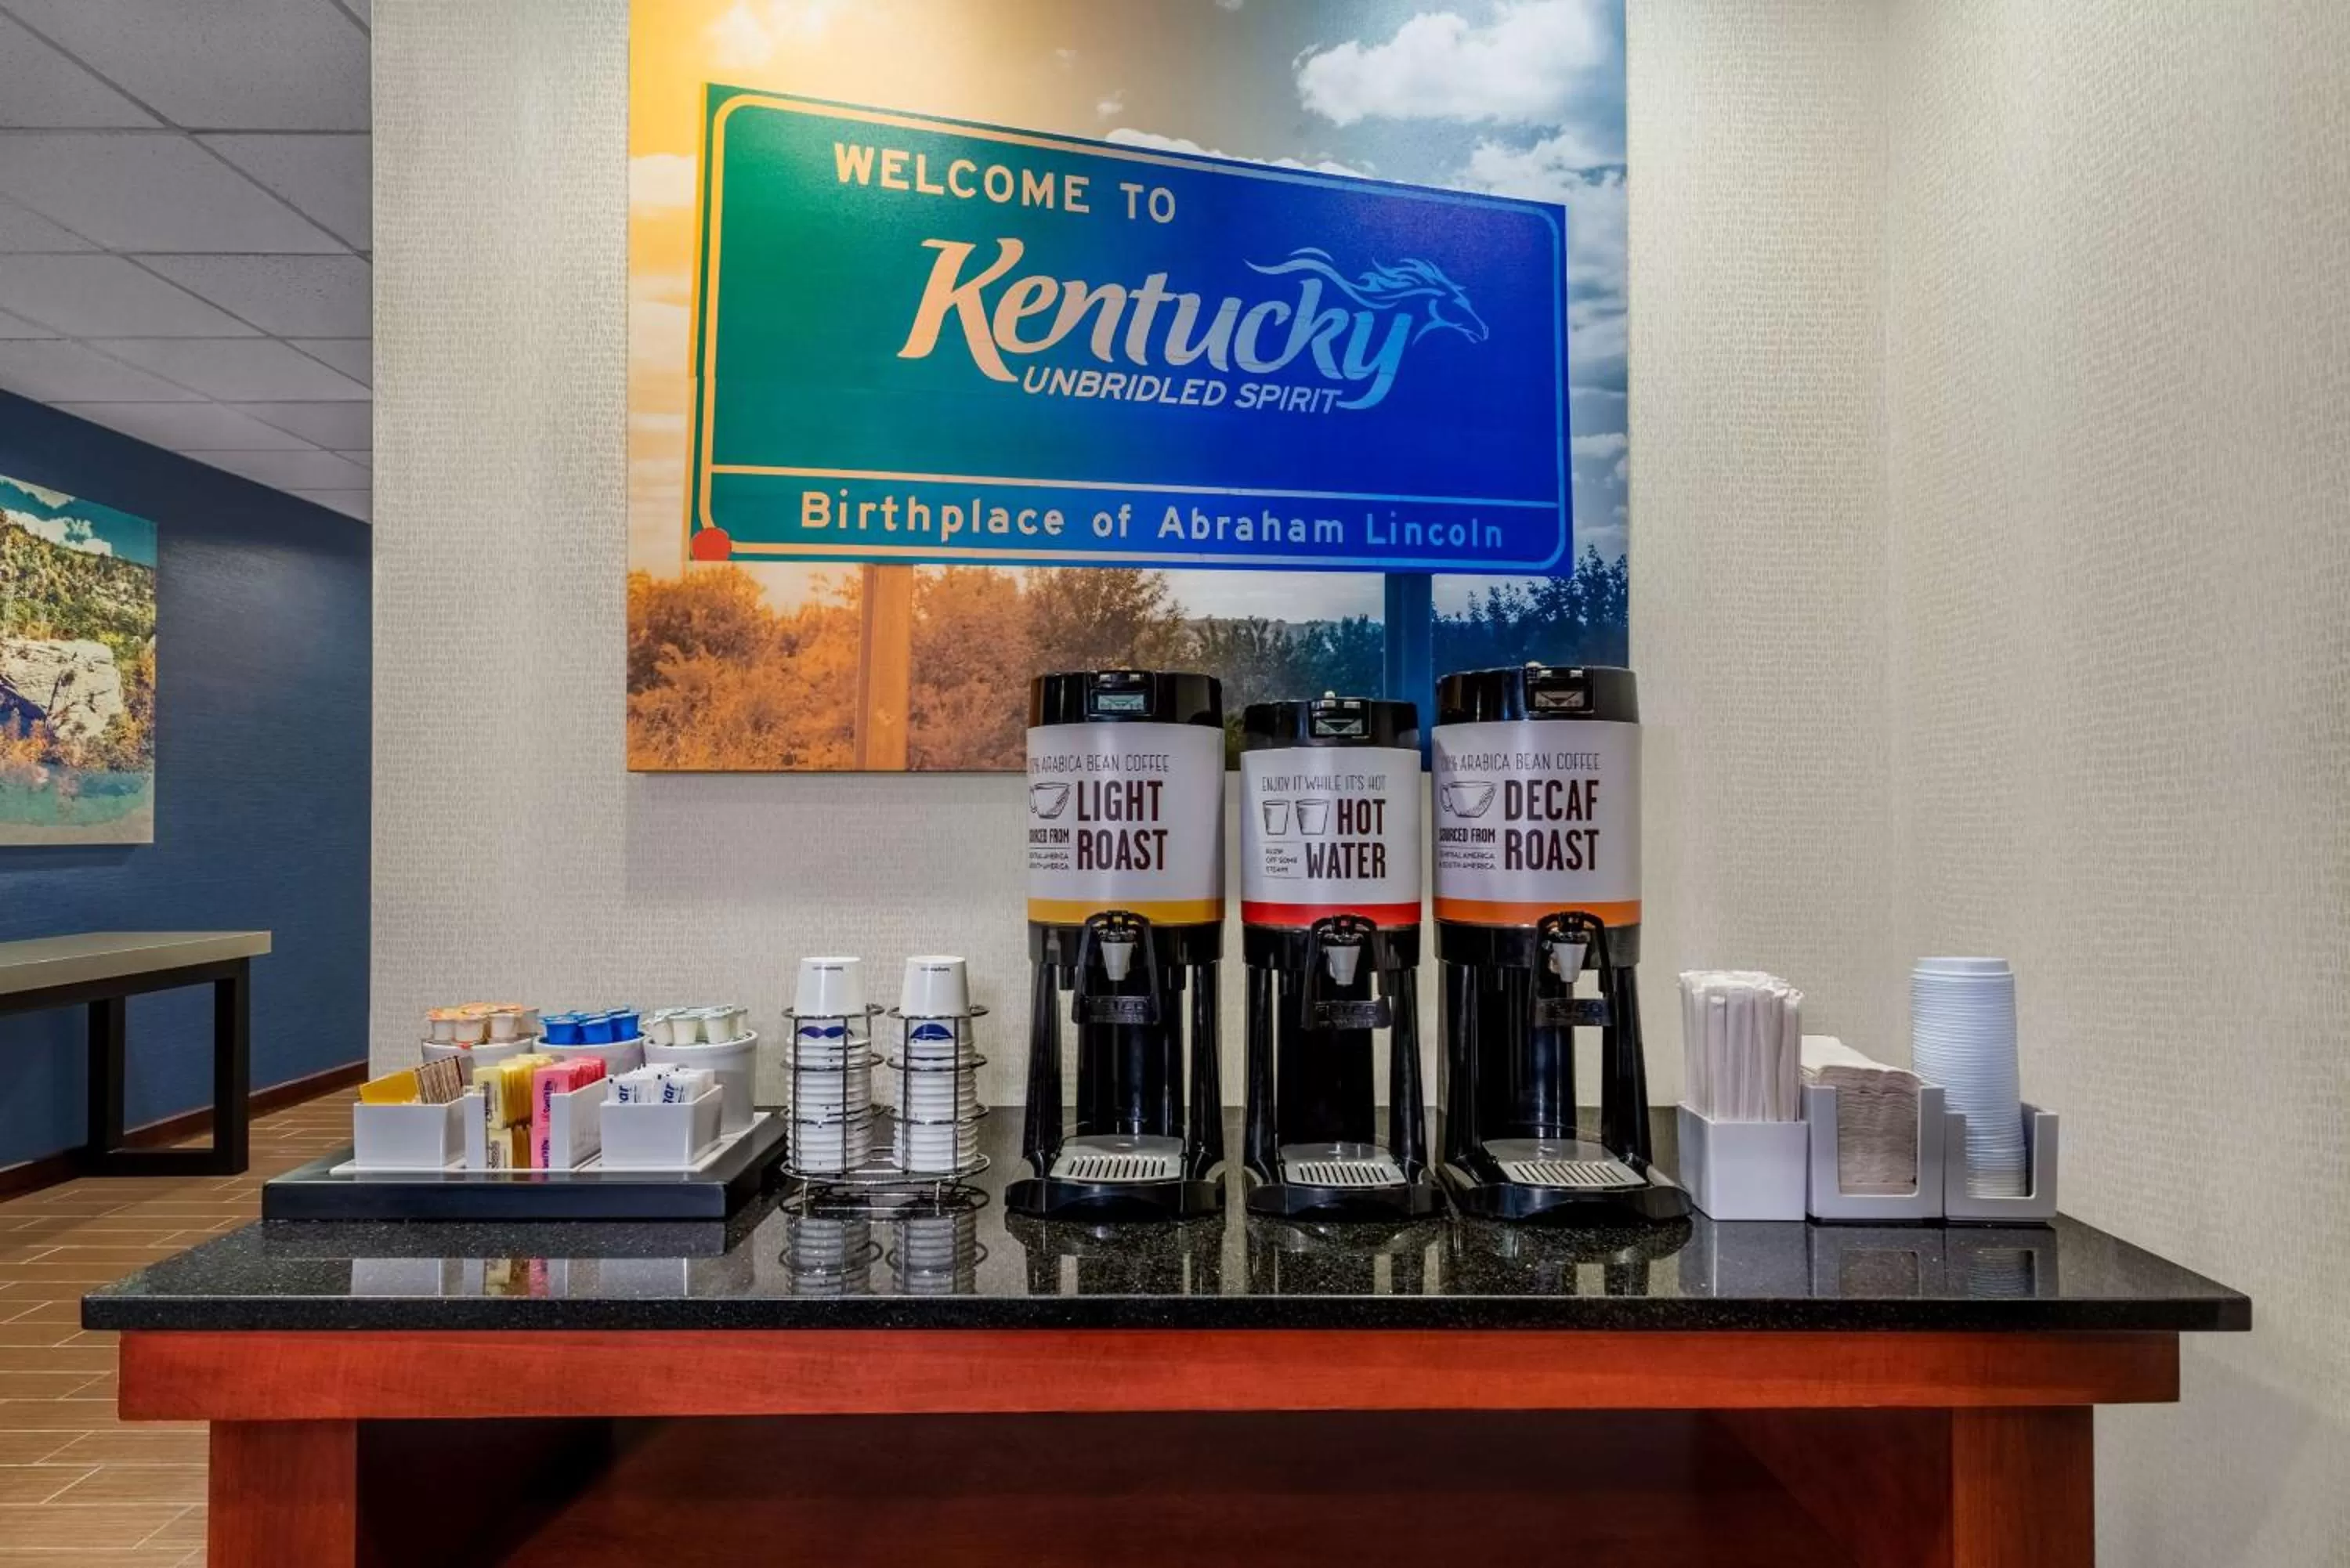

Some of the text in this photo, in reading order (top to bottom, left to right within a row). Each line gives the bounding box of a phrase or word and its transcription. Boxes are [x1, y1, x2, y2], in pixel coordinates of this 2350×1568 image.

[834, 143, 1176, 224] WELCOME TO
[897, 237, 1412, 409] Kentucky
[1023, 366, 1343, 414] UNBRIDLED SPIRIT
[801, 489, 1502, 548] Birthplace of Abraham Lincoln
[1042, 754, 1083, 773] ARABICA
[1086, 754, 1119, 772] BEAN
[1126, 754, 1170, 772] COFFEE
[1460, 753, 1511, 771] ARABICA
[1516, 753, 1550, 771] BEAN
[1556, 753, 1601, 771] COFFEE
[1077, 780, 1164, 822] LIGHT
[1262, 775, 1290, 792] ENJOY
[1293, 775, 1303, 791] IT
[1304, 775, 1342, 791] WHILE
[1368, 775, 1387, 791] HOT
[1504, 779, 1600, 822] DECAF
[1050, 828, 1070, 844] FROM
[1337, 798, 1386, 836] HOT
[1470, 828, 1496, 844] FROM
[1077, 829, 1168, 871] ROAST
[1305, 842, 1386, 879] WATER
[1504, 829, 1600, 871] ROAST
